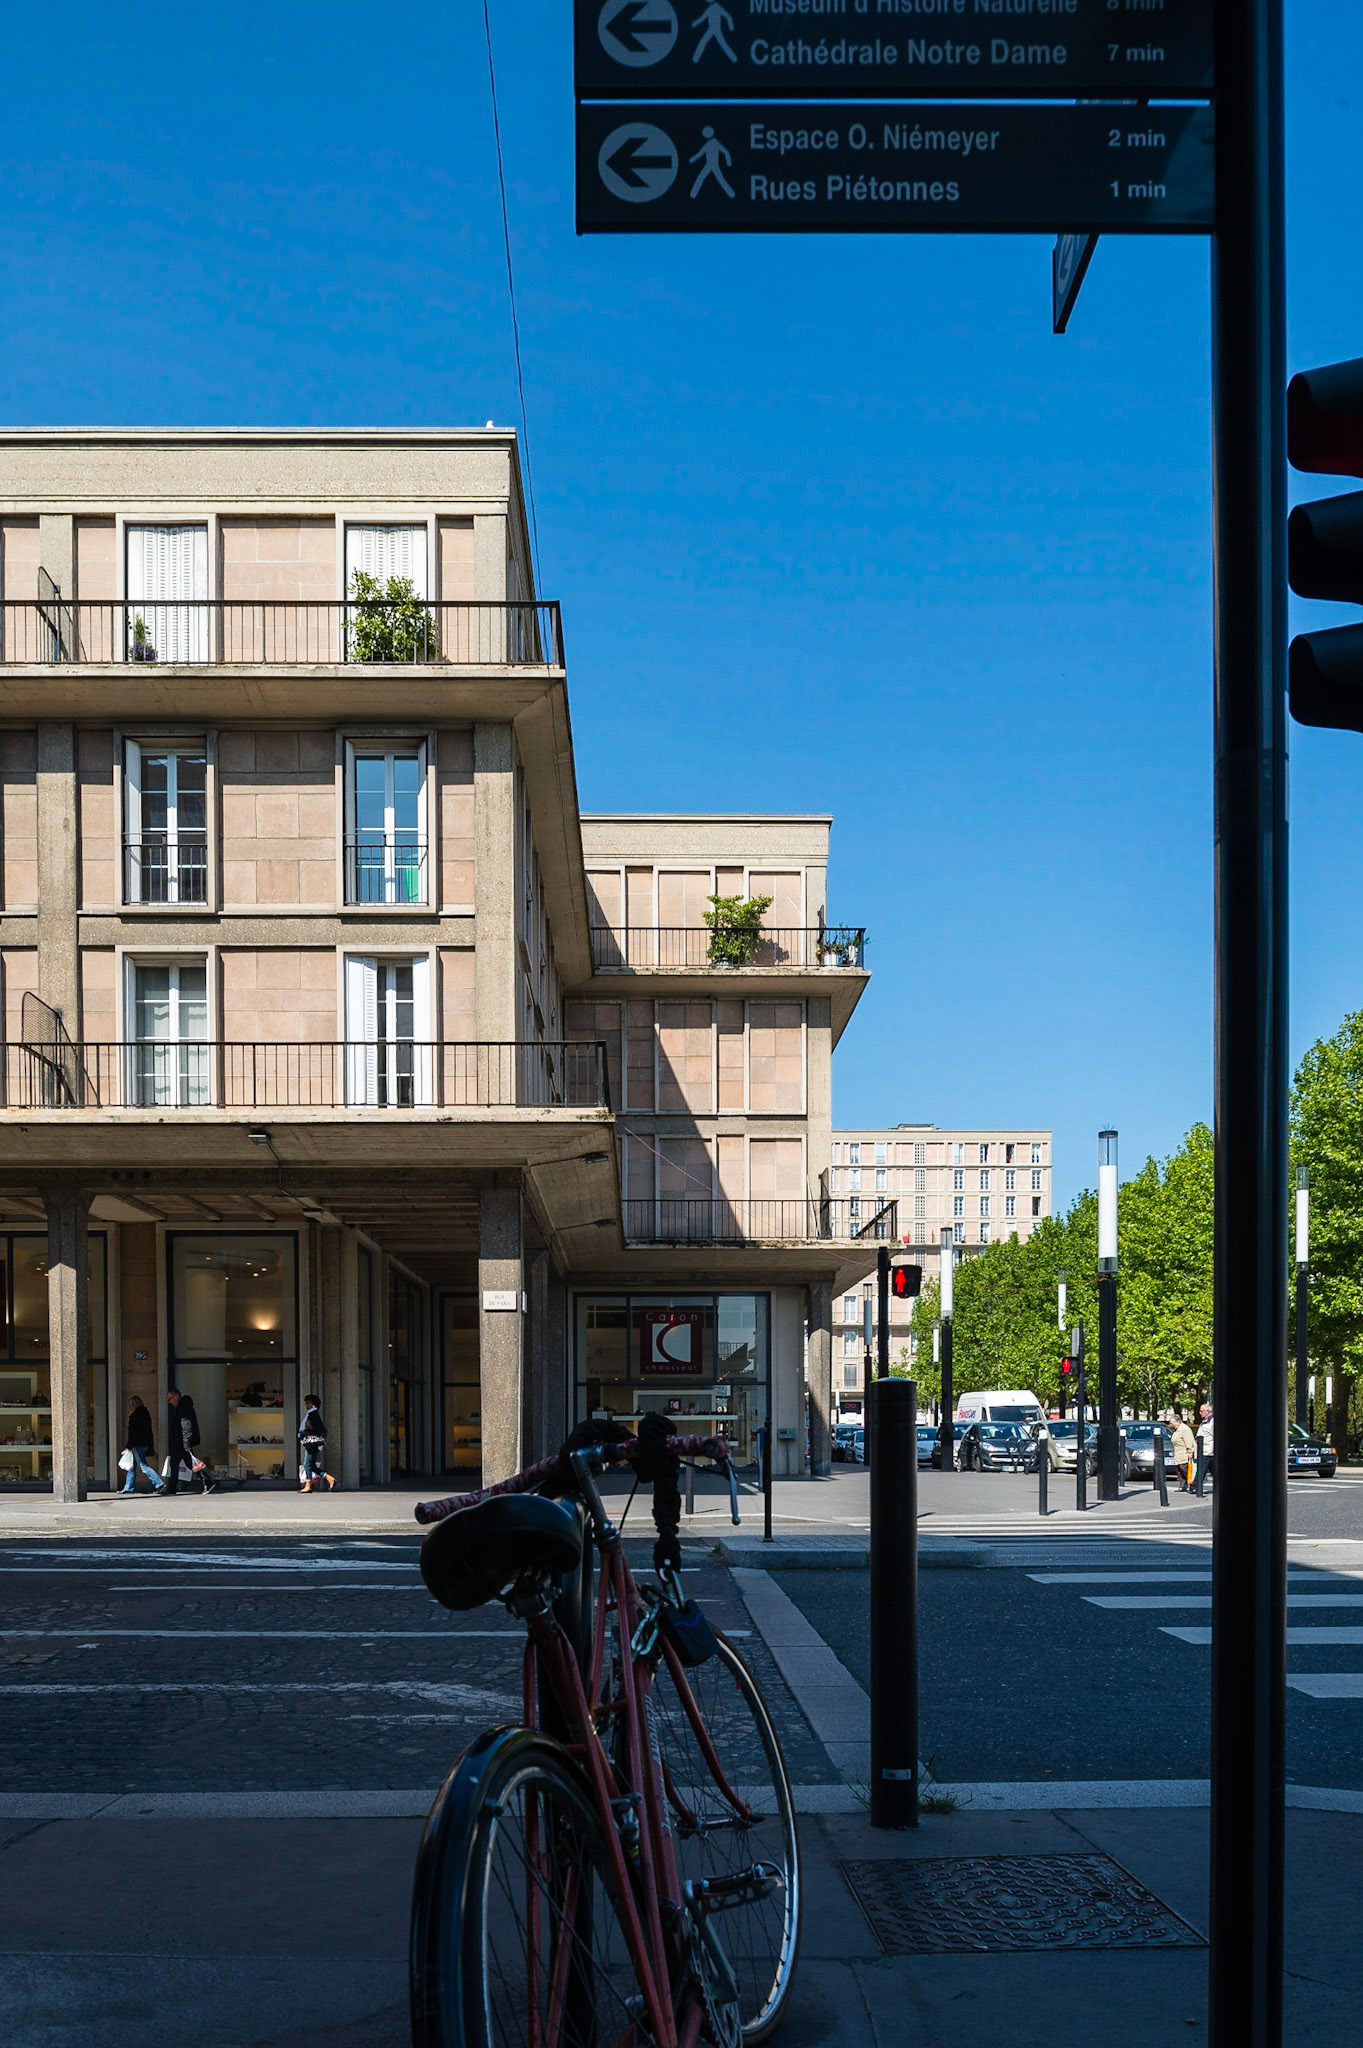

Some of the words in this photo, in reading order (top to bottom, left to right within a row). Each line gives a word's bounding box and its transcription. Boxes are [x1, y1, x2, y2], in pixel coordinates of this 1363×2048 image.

[750, 38, 898, 65] Cathédrale
[908, 39, 981, 65] Notre
[991, 39, 1068, 65] Dame
[1107, 44, 1120, 62] 7
[1126, 44, 1165, 61] min
[750, 123, 840, 156] Espace
[848, 123, 875, 150] O.
[883, 123, 1000, 157] Niémeyer
[1108, 129, 1121, 147] 2
[1127, 129, 1166, 147] min
[750, 175, 817, 201] Rues
[827, 173, 960, 201] Piétonnes
[1110, 180, 1120, 198] 1
[1128, 180, 1166, 198] min
[645, 1312, 699, 1322] Caron
[645, 1364, 699, 1372] chausseur
